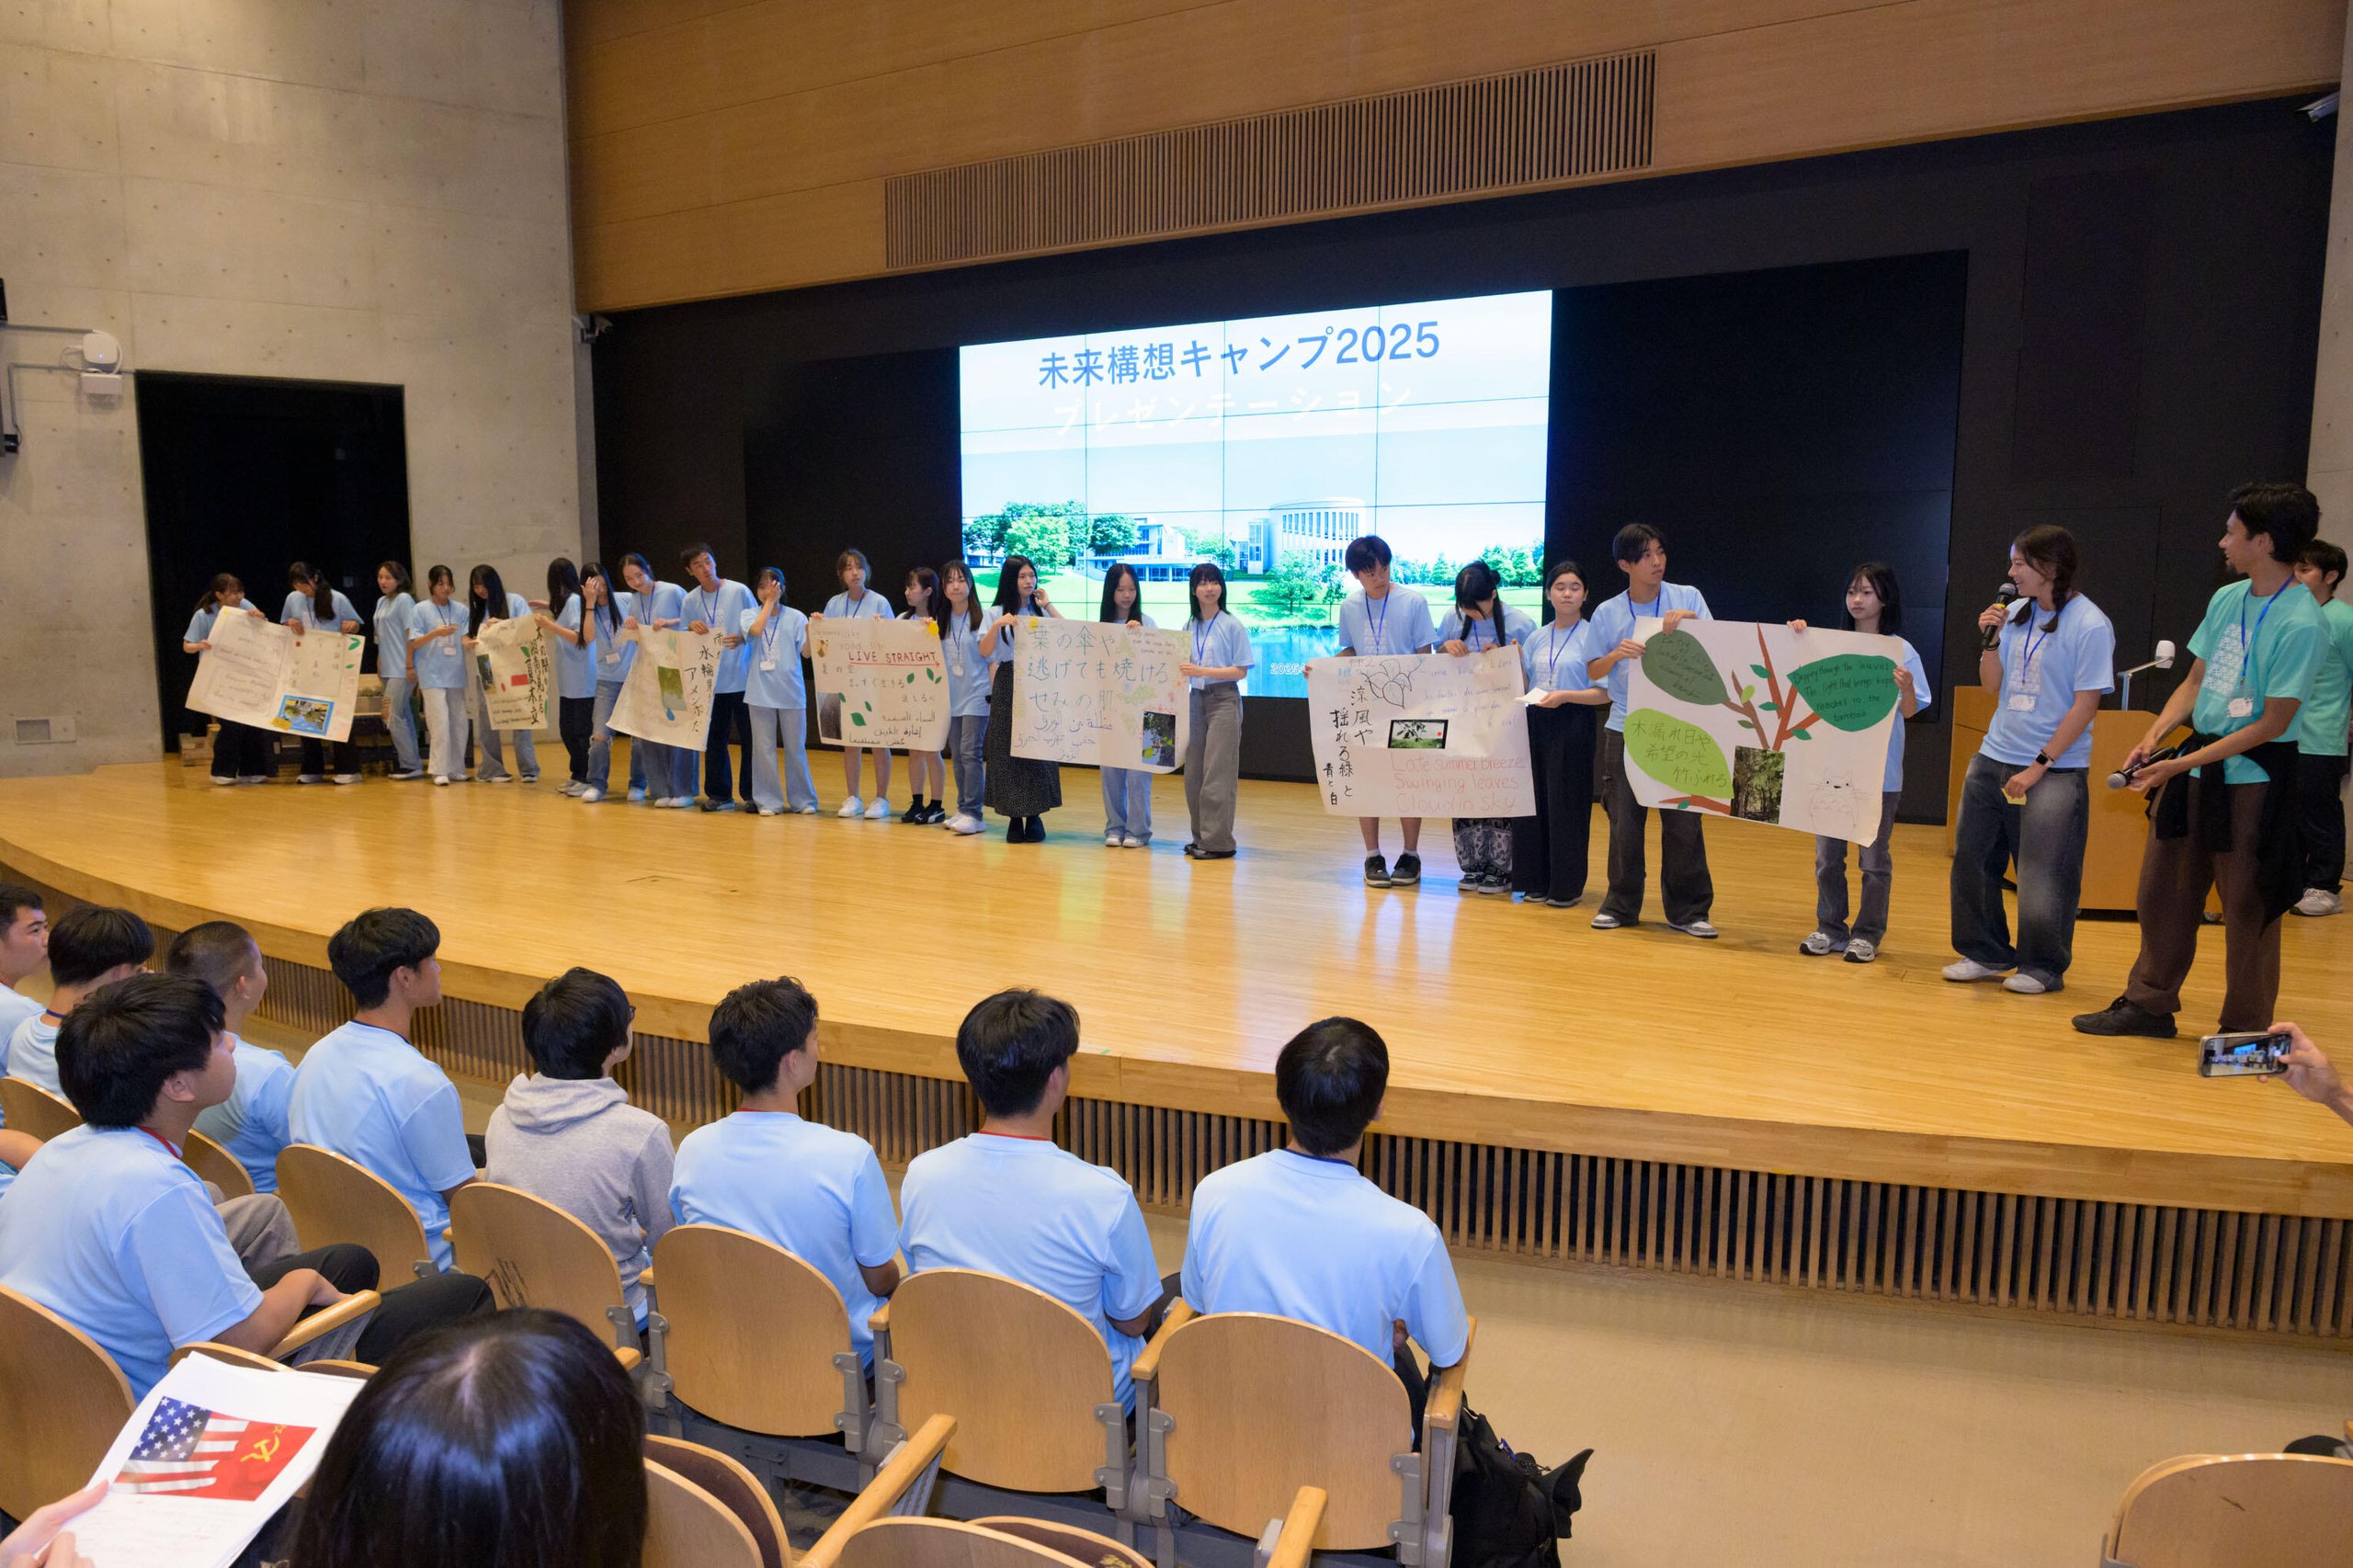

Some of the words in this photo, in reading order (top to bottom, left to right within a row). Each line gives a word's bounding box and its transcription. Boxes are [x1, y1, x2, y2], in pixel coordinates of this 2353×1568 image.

[1039, 321, 1439, 390] 未来構想キャンプ2025
[1054, 381, 1411, 436] プレゼンテーション
[1028, 625, 1115, 656] 葉の傘や
[848, 651, 879, 663] LIVE
[886, 651, 937, 664] STRAIGHT
[1027, 655, 1169, 685] 逃げても焼ける
[1029, 690, 1114, 713] せみの肌
[1391, 752, 1430, 772] Late
[1481, 756, 1527, 770] breeze
[1393, 772, 1466, 793] Swinging
[1472, 772, 1519, 790] leaves
